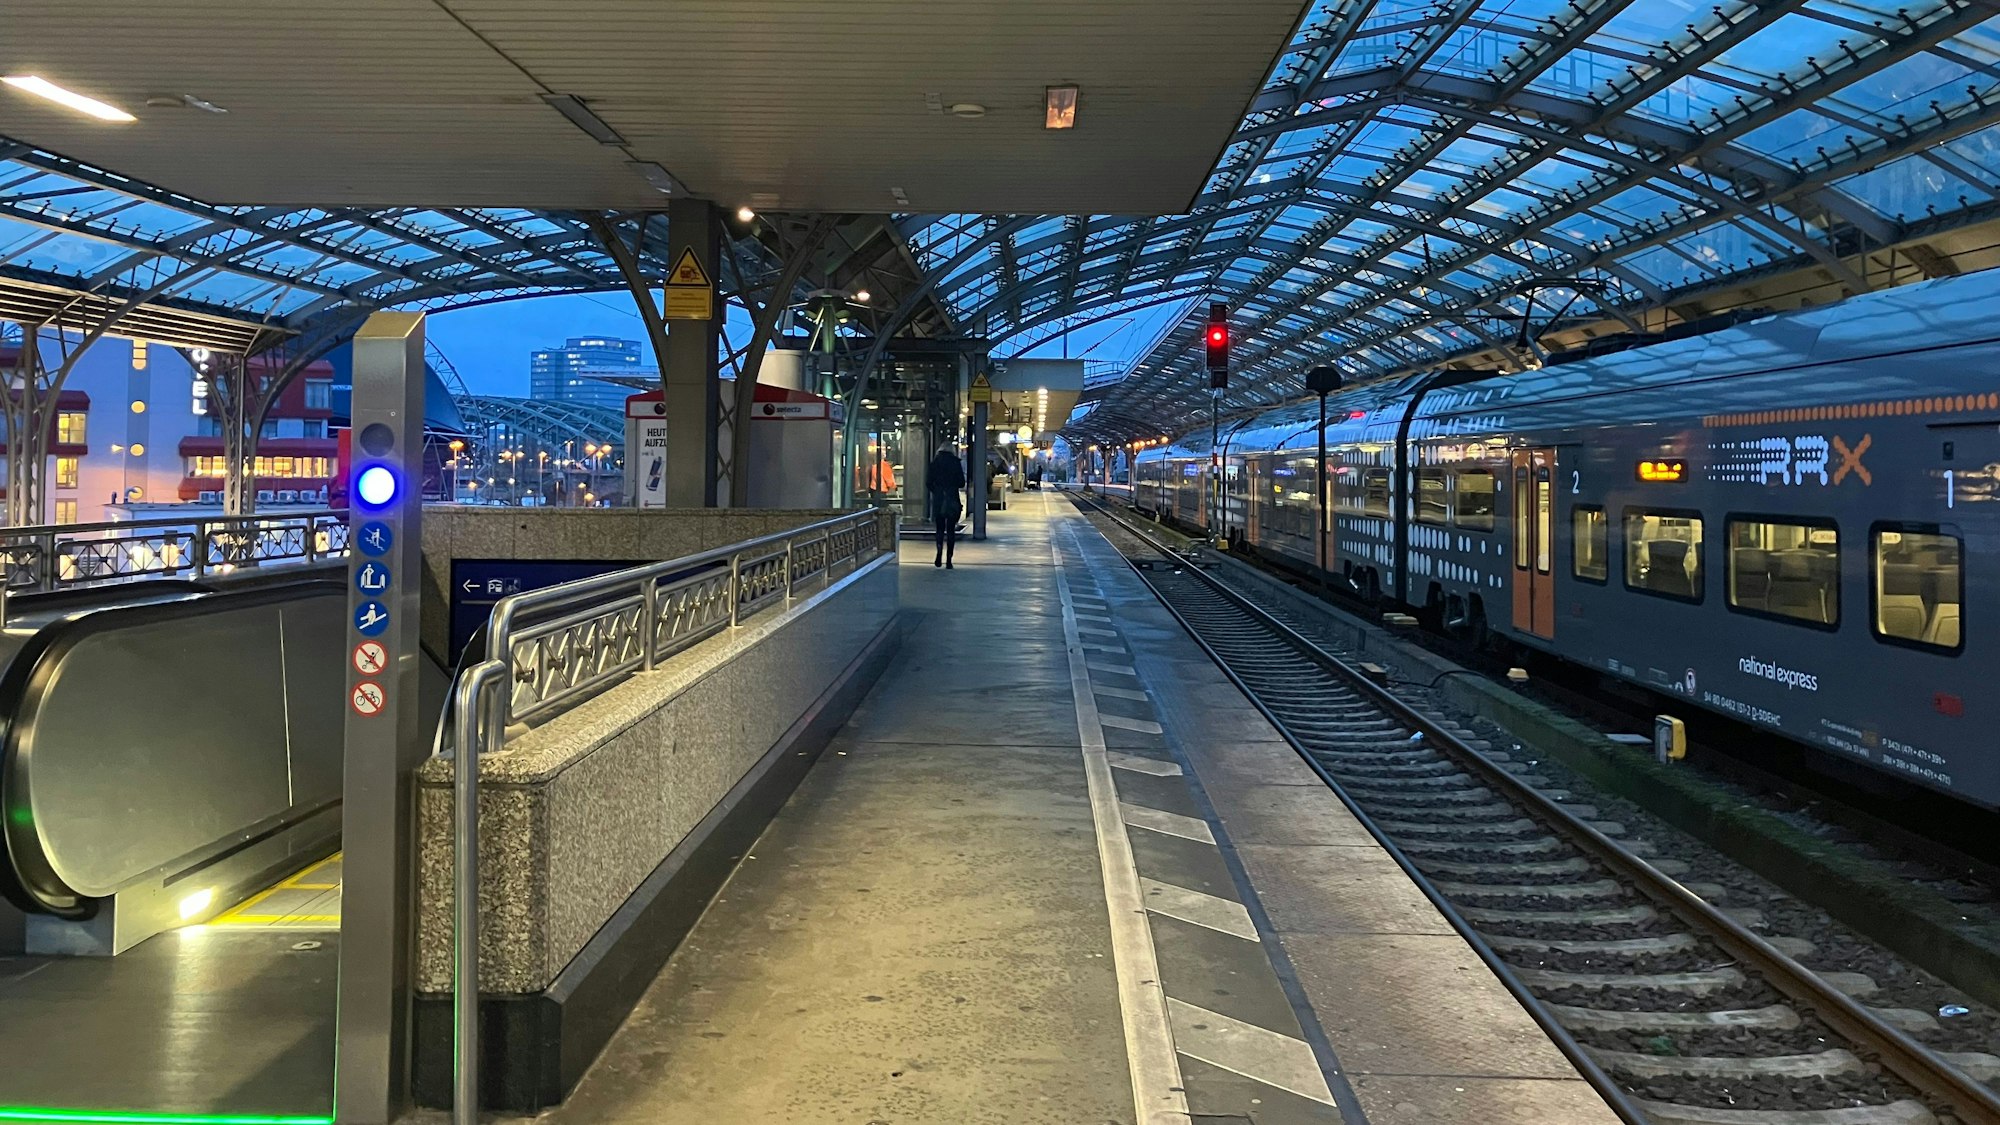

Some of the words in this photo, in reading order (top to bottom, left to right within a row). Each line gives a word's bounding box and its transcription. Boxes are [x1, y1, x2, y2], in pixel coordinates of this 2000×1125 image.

[1761, 433, 1872, 486] RRX
[1572, 470, 1580, 494] 2
[1943, 469, 1954, 509] 1
[1739, 655, 1776, 680] national
[1776, 667, 1818, 691] express
